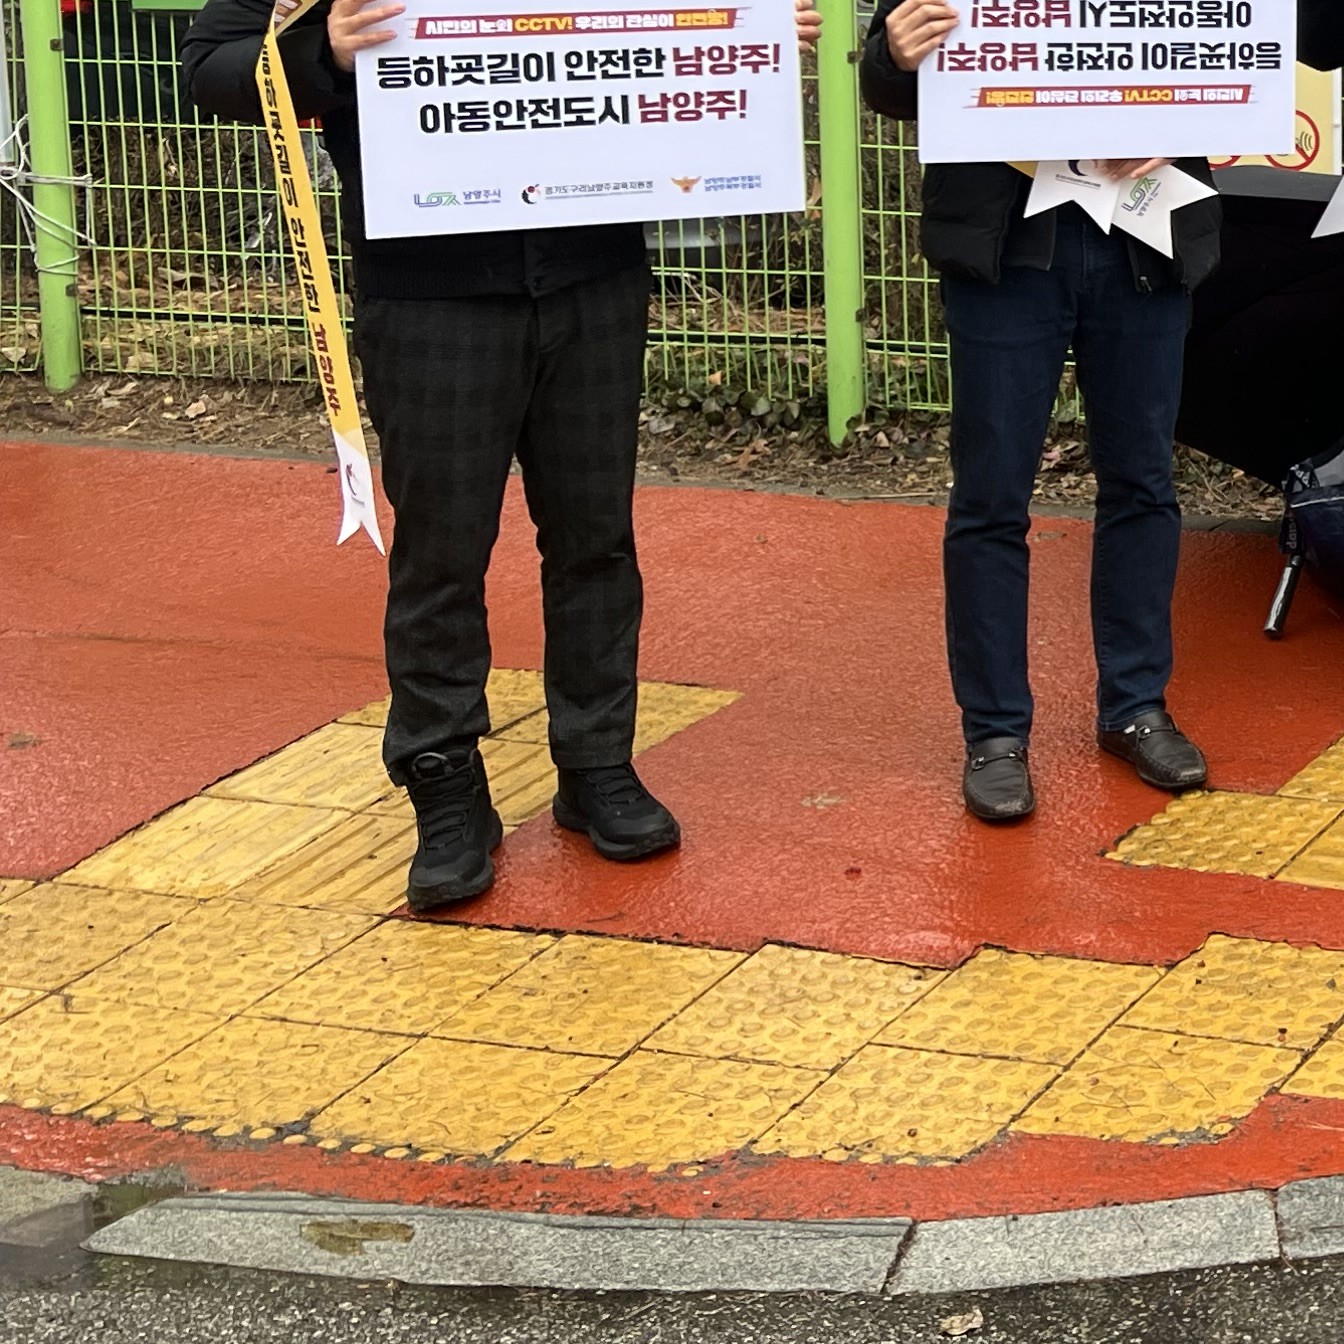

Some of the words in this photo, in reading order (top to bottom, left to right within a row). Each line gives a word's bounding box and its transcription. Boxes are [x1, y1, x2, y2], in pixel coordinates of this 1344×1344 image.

[514, 16, 573, 32] CCTV!
[1079, 0, 1251, 28] 아동안전도시
[376, 51, 556, 88] 등하굣길이
[563, 47, 666, 80] 안전한
[672, 43, 781, 76] 남양주!
[936, 42, 1038, 71] 남양주!
[1044, 42, 1133, 70] 안전한
[419, 94, 629, 134] 아동안전도시
[638, 89, 747, 123] 남양주!
